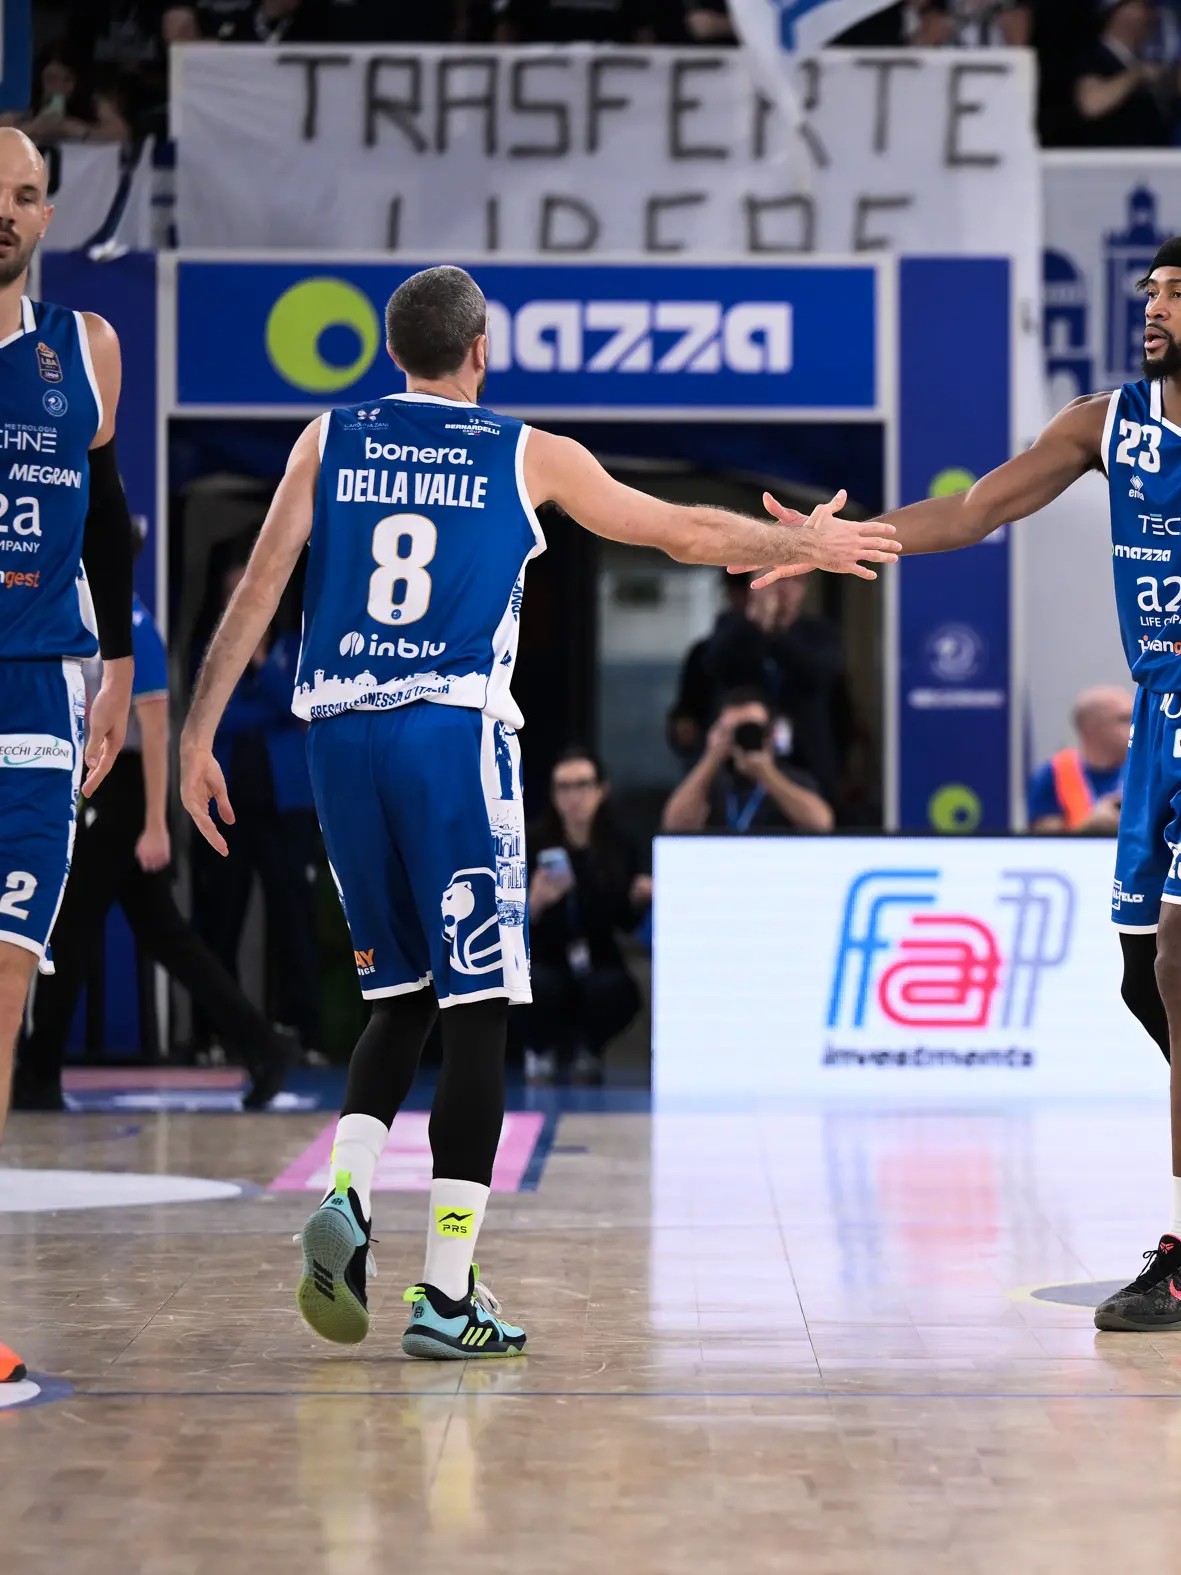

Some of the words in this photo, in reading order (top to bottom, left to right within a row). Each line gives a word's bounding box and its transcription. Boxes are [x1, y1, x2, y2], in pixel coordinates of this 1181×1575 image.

[277, 55, 1010, 172] TRASFERTE
[4, 423, 58, 433] METROLOGIA
[444, 423, 501, 436] BERNARDELLI
[0, 429, 58, 453] HNE
[365, 437, 474, 465] bonera.
[1116, 418, 1162, 473] 23
[336, 468, 408, 505] DELLA
[414, 472, 488, 509] VALLE
[1115, 544, 1172, 562] mazza
[368, 512, 437, 625] 8
[1139, 616, 1162, 627] LIFE
[368, 633, 447, 659] inblu
[33, 746, 70, 758] ZIRONI
[824, 1040, 1034, 1068] investments
[442, 1224, 467, 1234] PRS
